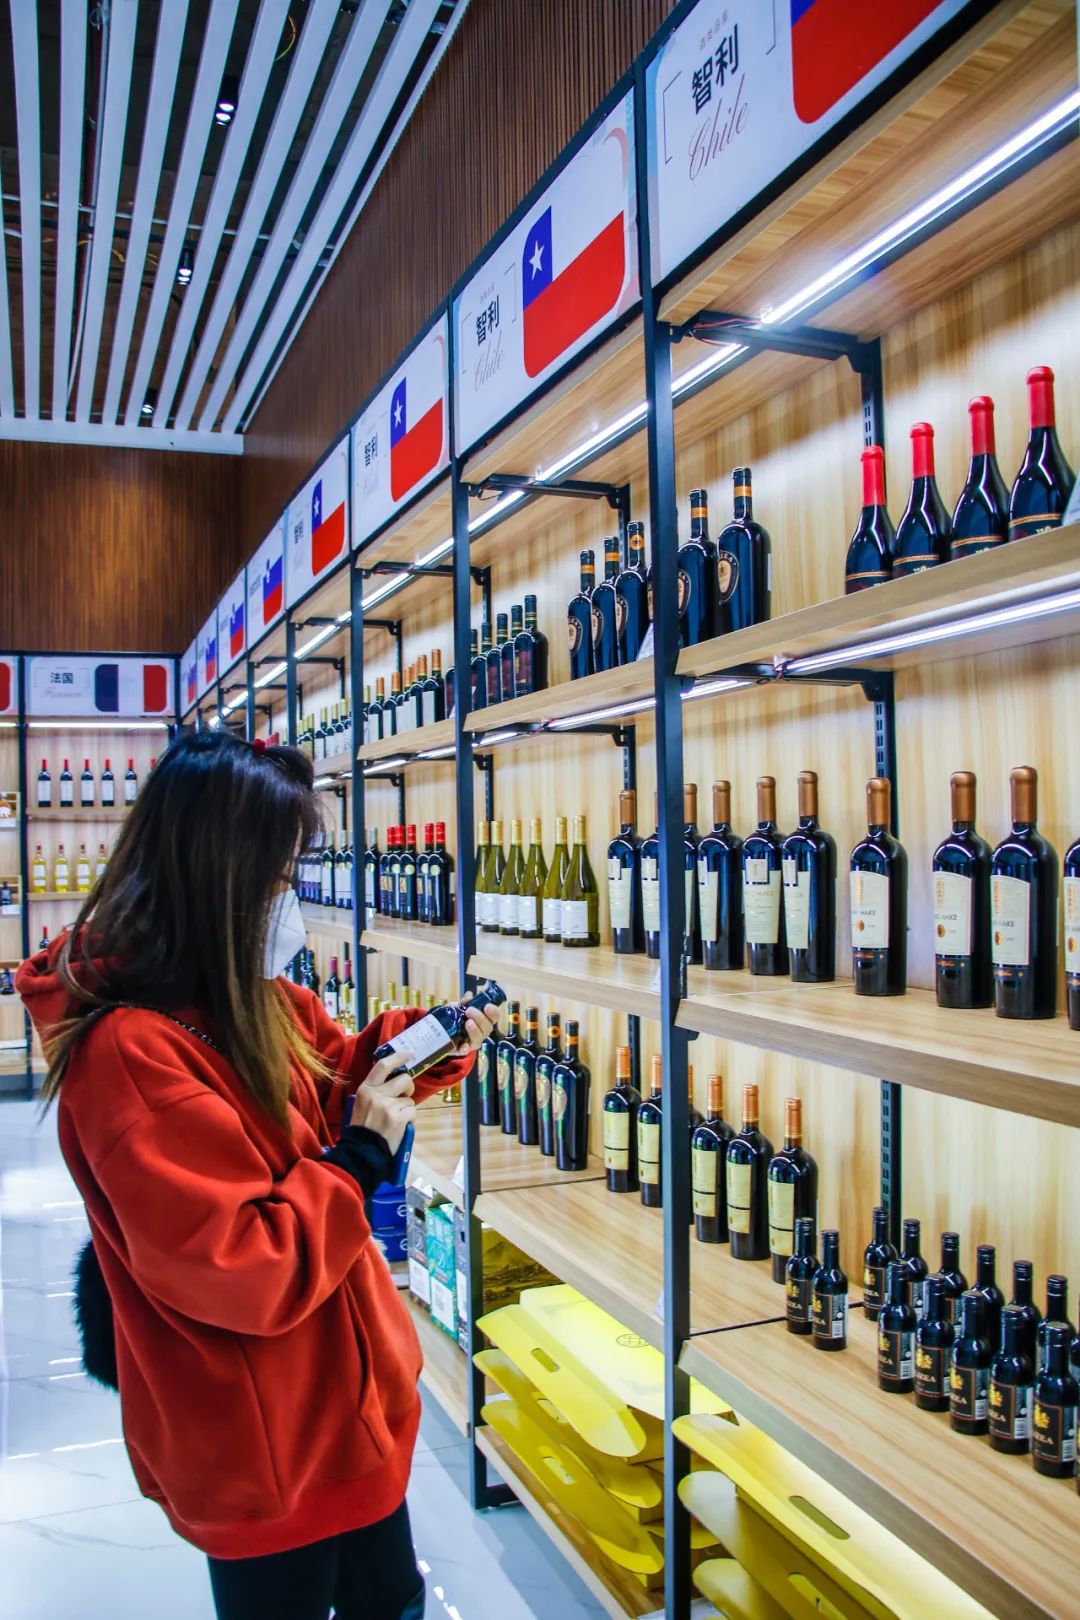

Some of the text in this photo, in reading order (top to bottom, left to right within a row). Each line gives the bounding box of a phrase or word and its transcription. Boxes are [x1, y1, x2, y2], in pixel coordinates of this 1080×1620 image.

[691, 23, 739, 115] 智利
[689, 72, 748, 187] Chile
[476, 294, 500, 346] 智利
